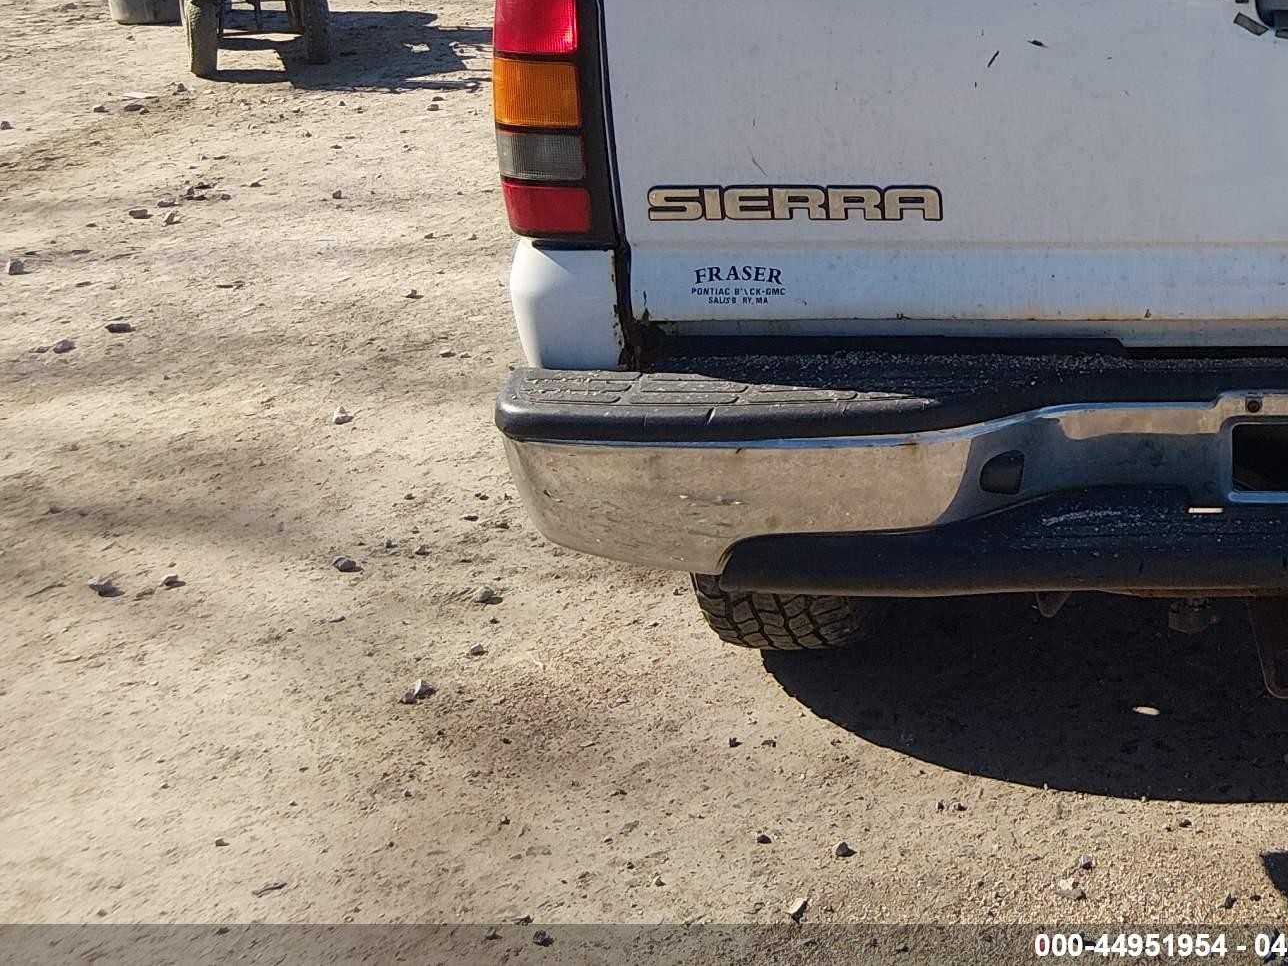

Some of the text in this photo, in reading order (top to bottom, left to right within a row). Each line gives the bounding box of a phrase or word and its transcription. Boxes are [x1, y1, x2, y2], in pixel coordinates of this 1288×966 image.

[647, 184, 943, 222] SIERRA
[694, 265, 783, 285] FRASER
[691, 287, 731, 296] PONTIAC
[755, 296, 769, 305] MA
